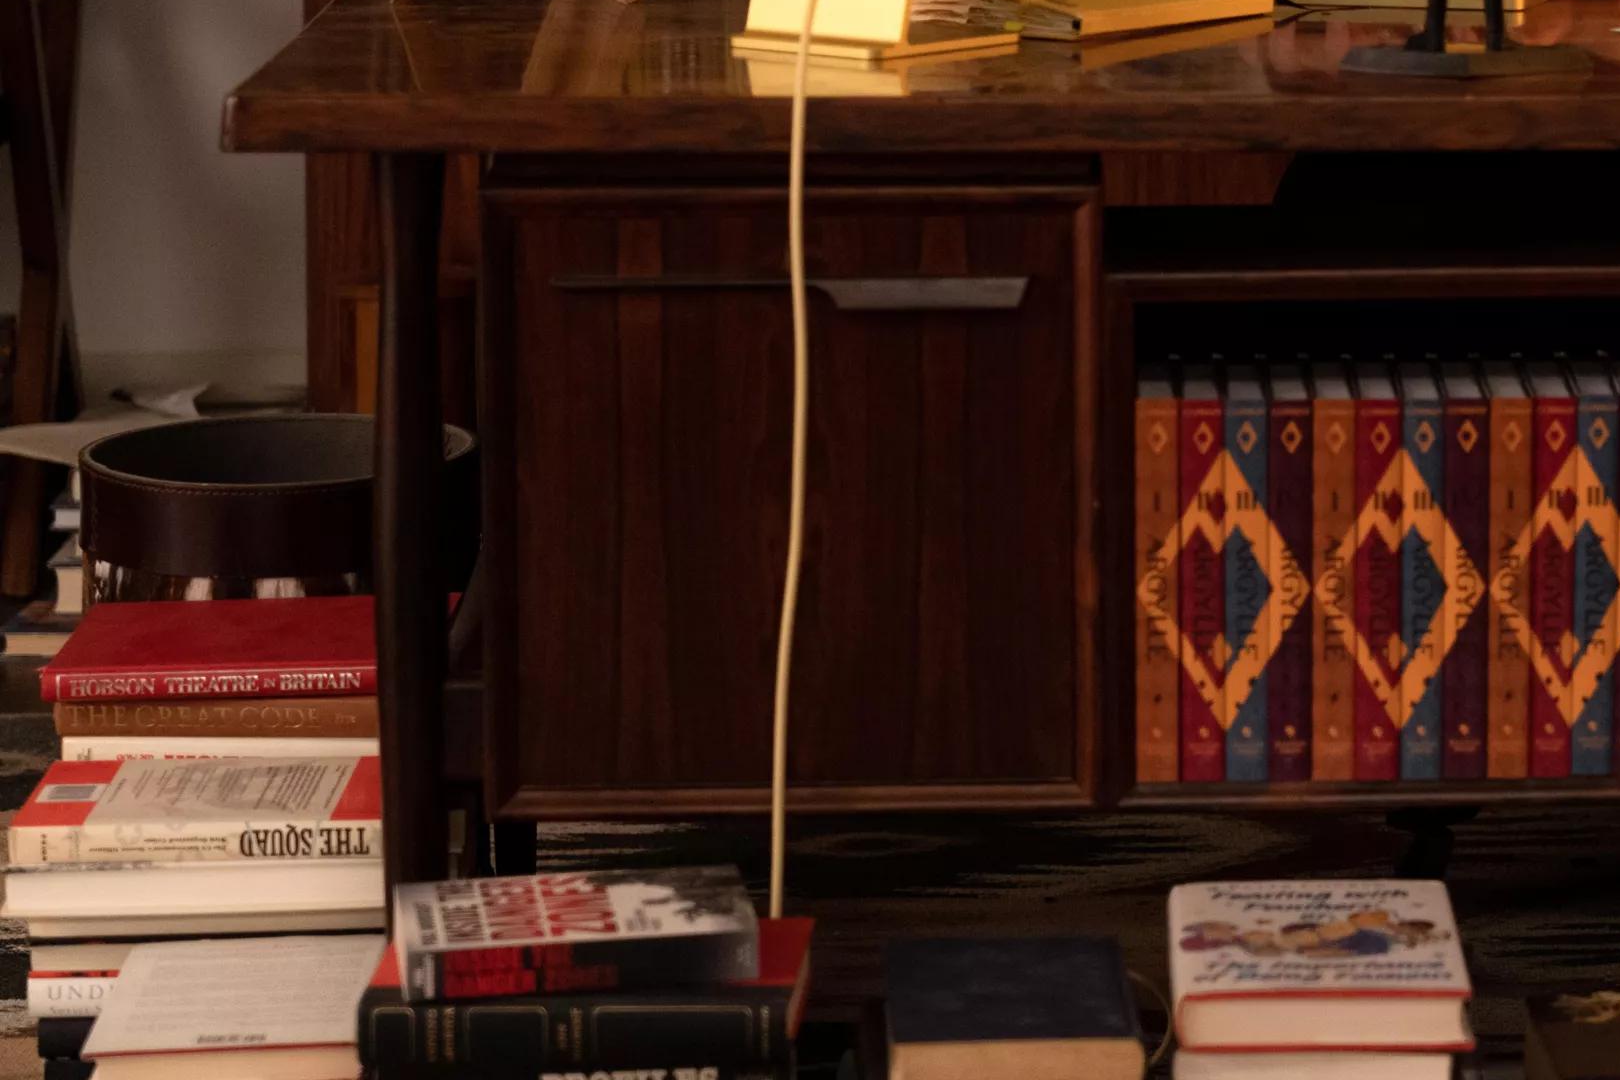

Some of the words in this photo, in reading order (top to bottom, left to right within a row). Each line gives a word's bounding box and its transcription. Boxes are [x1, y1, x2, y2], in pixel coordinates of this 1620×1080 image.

[69, 680, 156, 698] HOBSON
[164, 675, 260, 695] THEATRE
[279, 672, 361, 691] BRITAIN
[66, 705, 130, 728] THE
[136, 704, 234, 727] GREAT
[239, 704, 320, 728] CODE
[238, 823, 314, 858] SQUAD
[319, 827, 370, 857] THE
[48, 984, 114, 1001] UND
